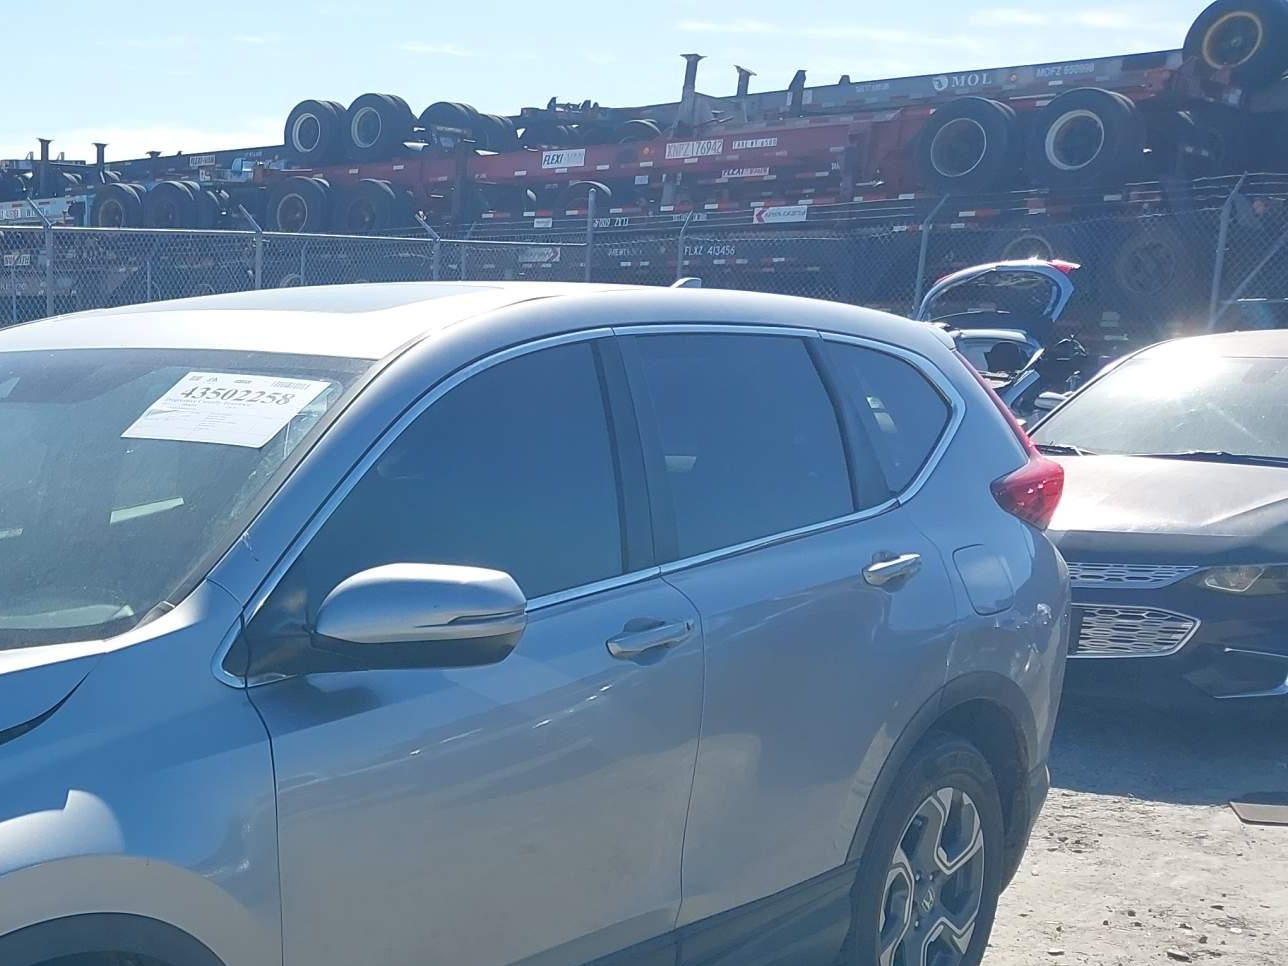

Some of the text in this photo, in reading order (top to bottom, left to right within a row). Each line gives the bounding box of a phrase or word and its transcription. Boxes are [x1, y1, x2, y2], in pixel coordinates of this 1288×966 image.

[951, 71, 993, 88] MOL
[684, 245, 703, 256] FLXZ
[179, 384, 296, 406] 43502258
